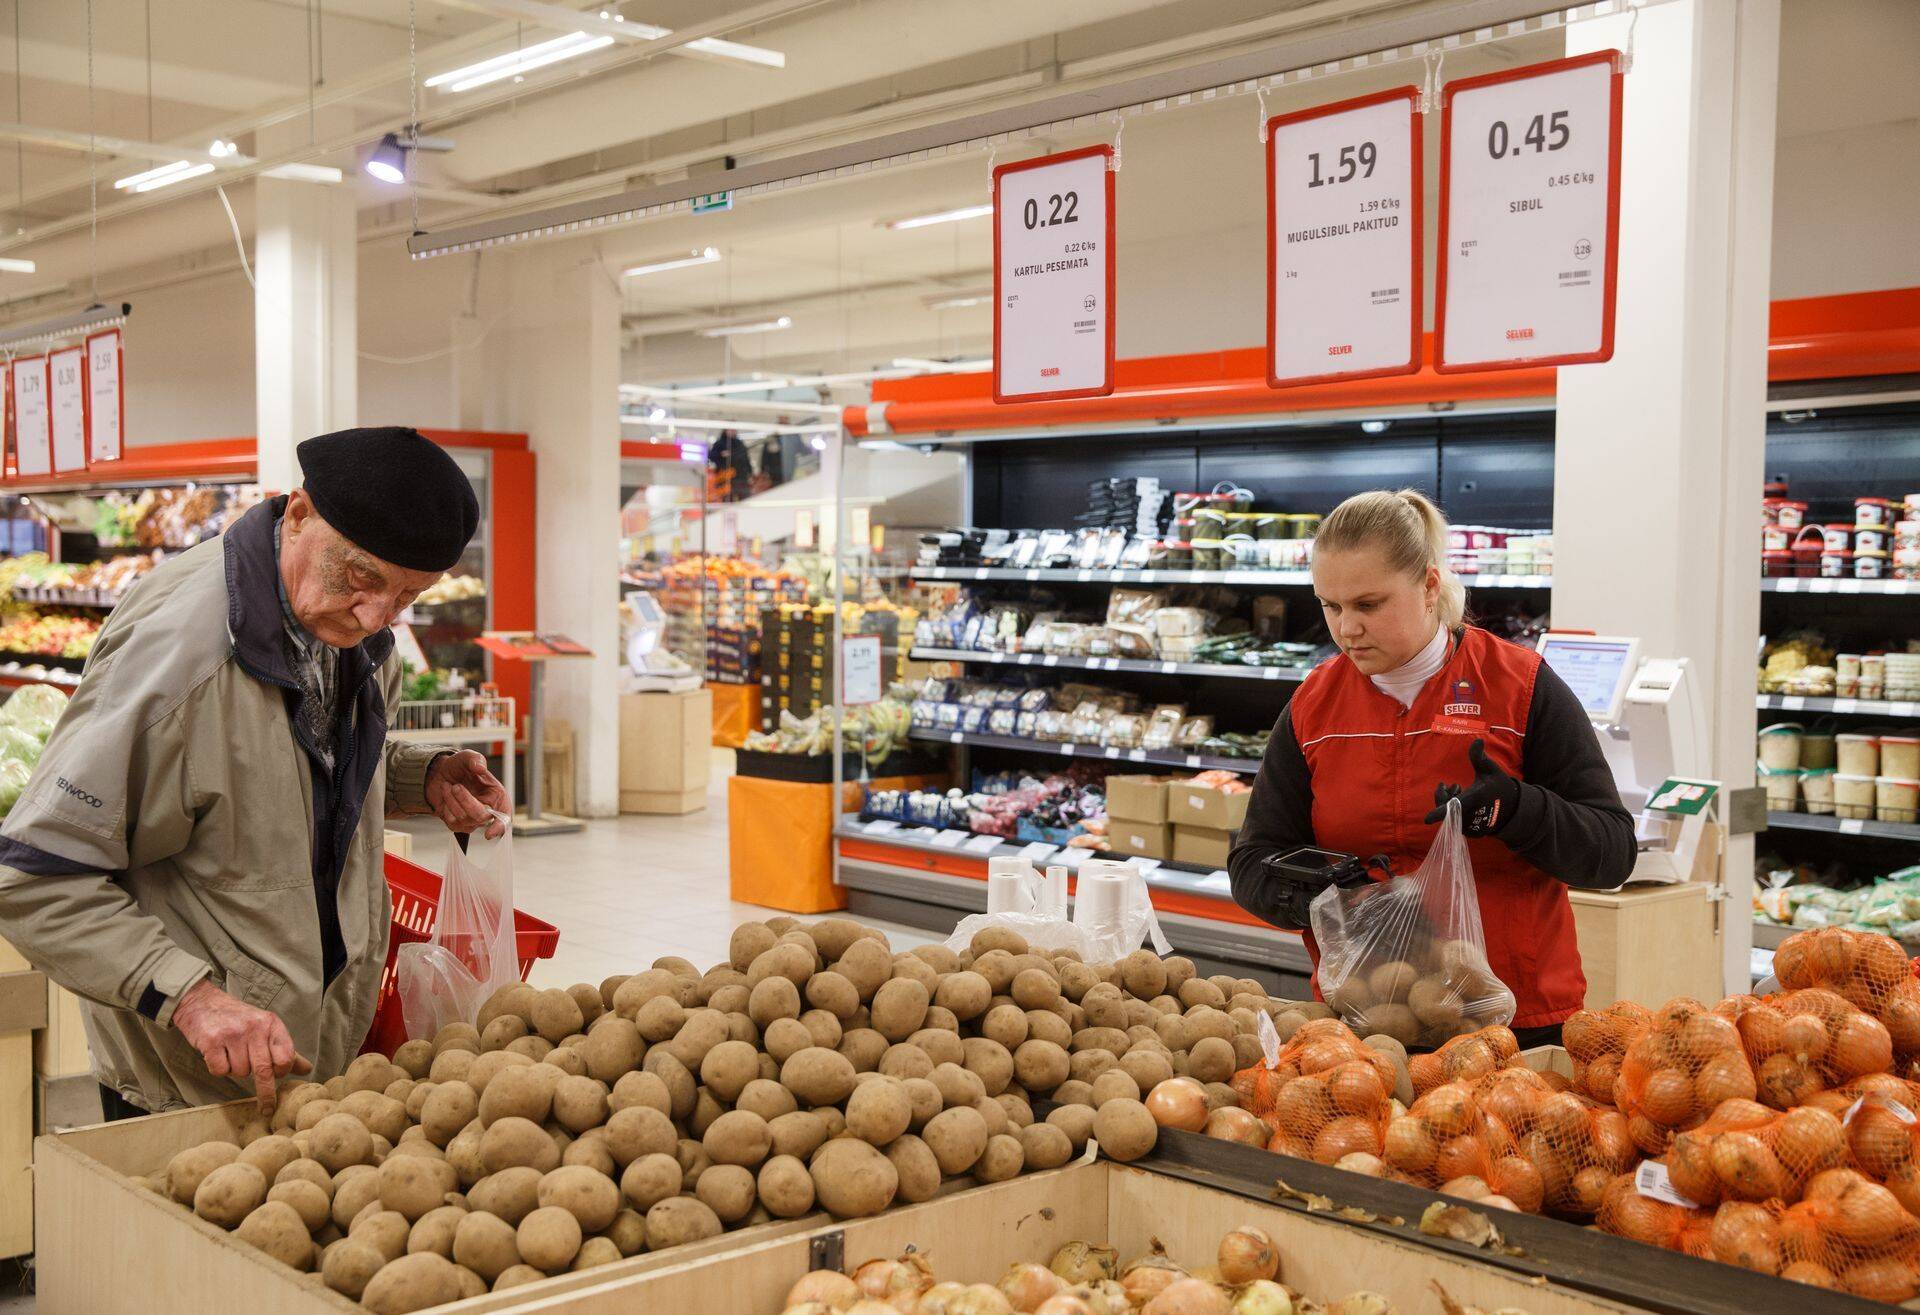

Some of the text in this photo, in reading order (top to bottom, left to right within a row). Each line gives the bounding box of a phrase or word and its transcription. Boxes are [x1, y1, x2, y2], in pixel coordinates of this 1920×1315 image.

[1488, 110, 1570, 160] 0.45
[1307, 141, 1377, 189] 1.59
[1548, 173, 1594, 188] 0.45 €/kg
[1024, 190, 1079, 230] 0.22
[1360, 200, 1379, 212] 1.59
[1509, 199, 1543, 213] SIBUL
[1287, 216, 1399, 243] MUGULSIBUL PAKITUD
[1064, 243, 1080, 253] 0.22
[1461, 240, 1478, 248] EESTI
[1575, 245, 1591, 255] 128
[1014, 258, 1089, 277] KARTUL PESEMATA
[1506, 329, 1534, 340] SELVER
[1328, 345, 1352, 356] SELVER
[1040, 367, 1060, 377] SELVER
[1446, 704, 1479, 714] SELVER
